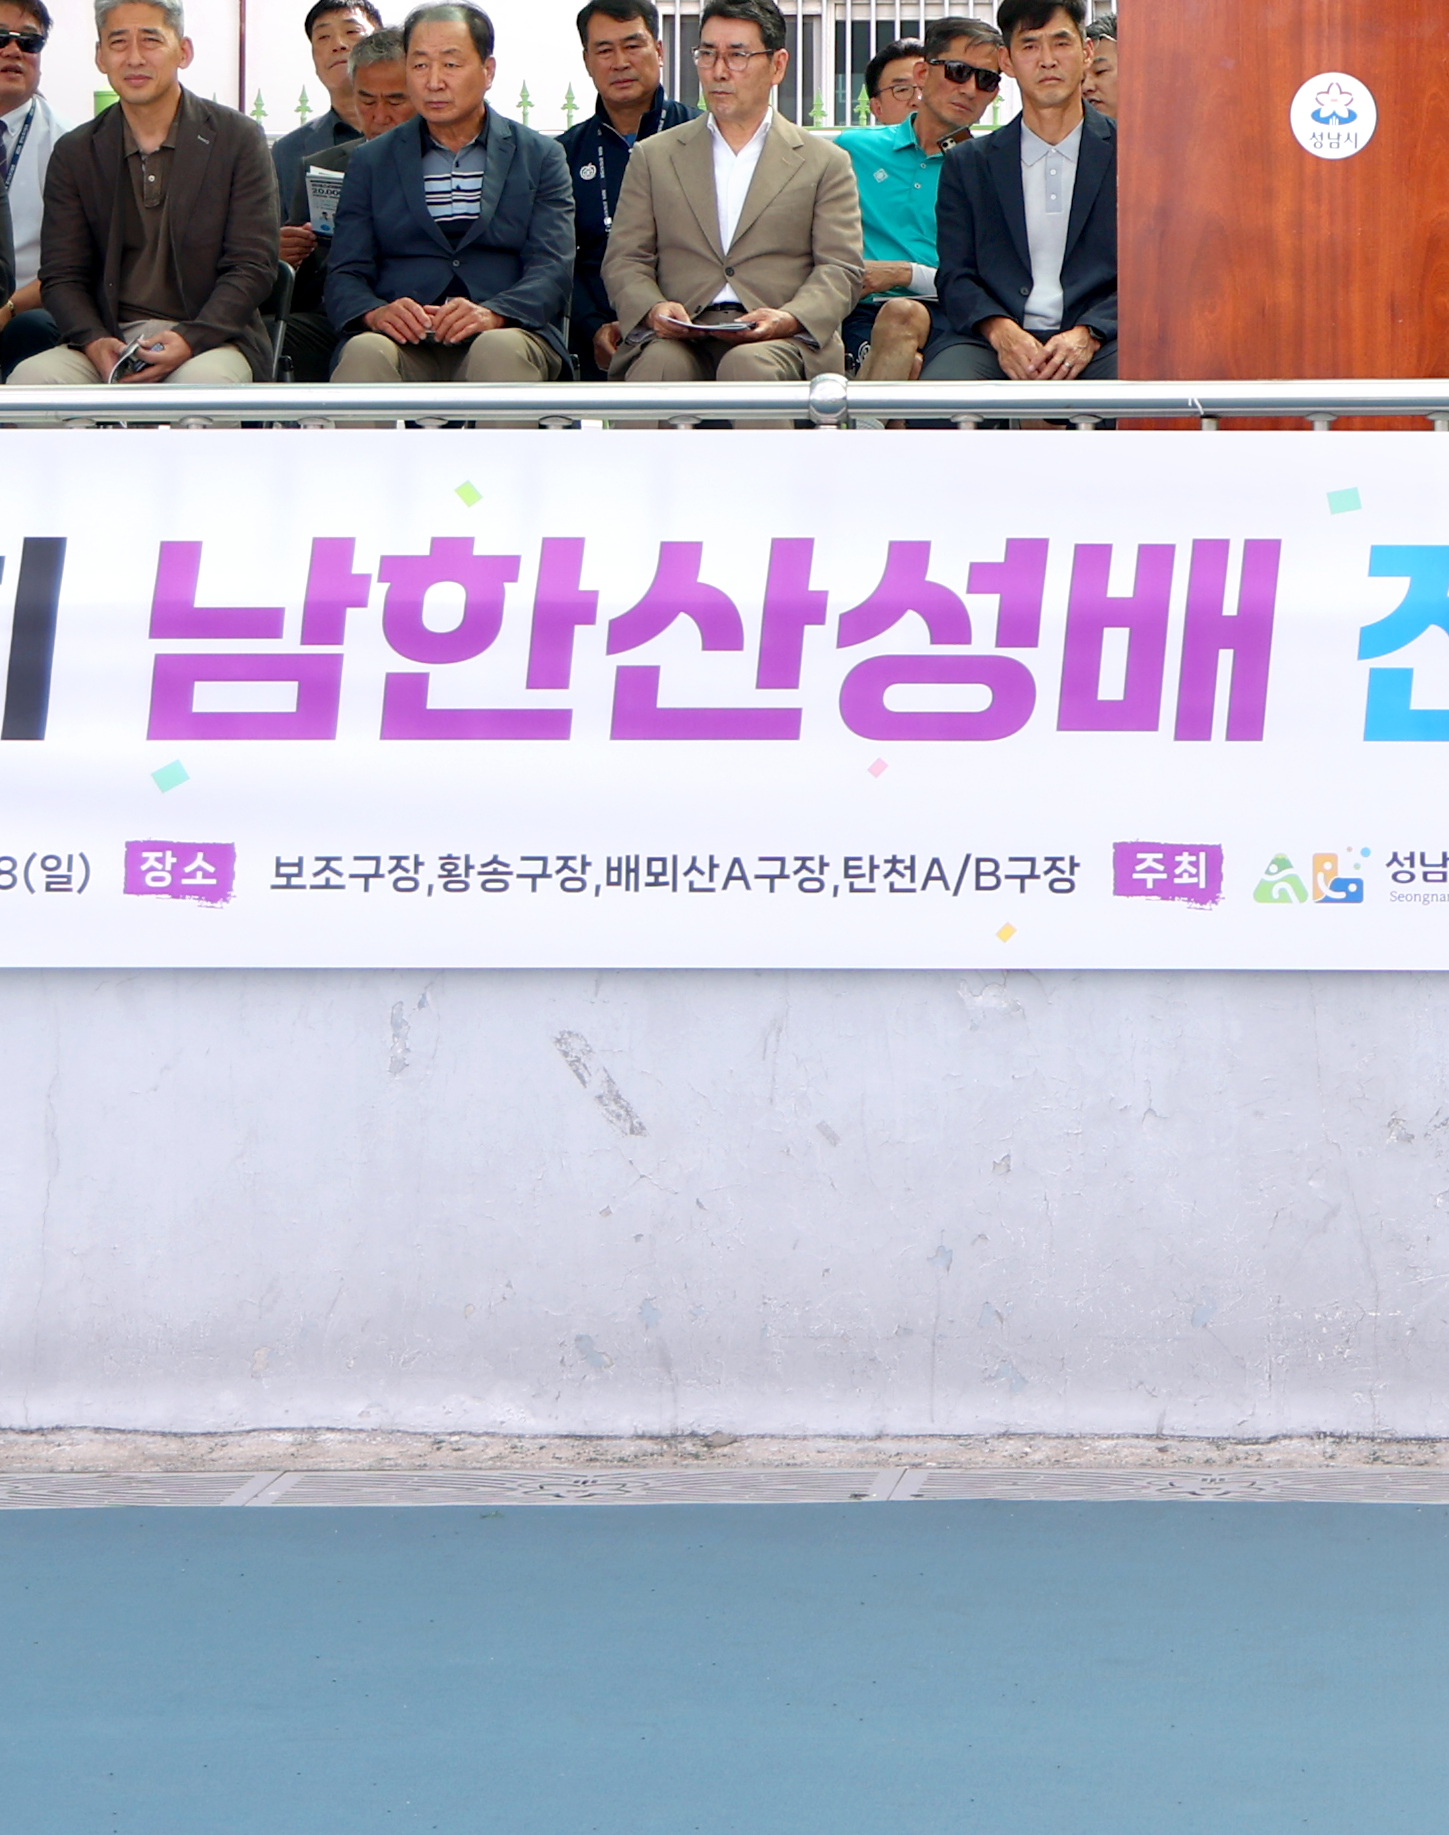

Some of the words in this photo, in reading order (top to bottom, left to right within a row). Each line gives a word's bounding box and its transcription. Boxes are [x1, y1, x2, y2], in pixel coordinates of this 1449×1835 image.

[1309, 132, 1358, 150] 성남시
[147, 537, 1281, 741] 남한산성배
[141, 851, 217, 887] 장소
[1133, 852, 1205, 888] 주최
